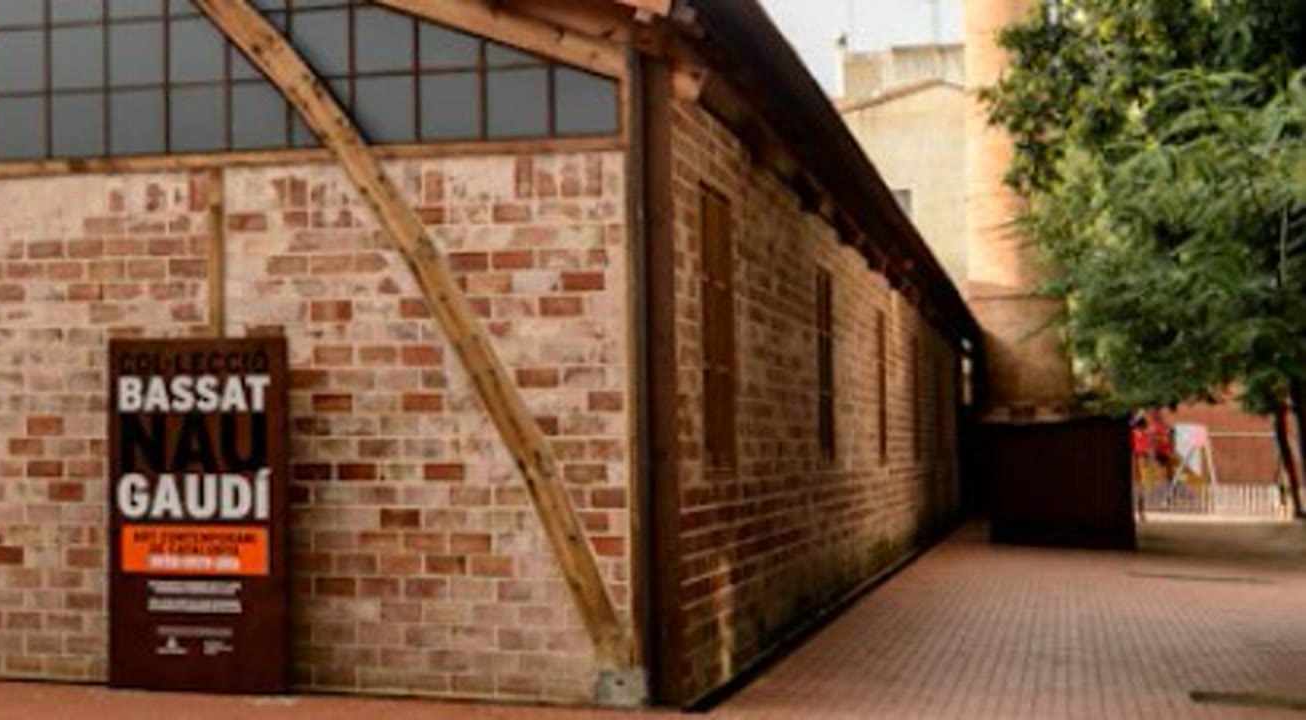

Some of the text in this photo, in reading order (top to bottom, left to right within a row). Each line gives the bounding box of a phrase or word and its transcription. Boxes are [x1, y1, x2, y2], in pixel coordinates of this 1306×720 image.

[118, 374, 271, 413] BASSAT
[119, 412, 268, 473] NAU
[117, 467, 272, 520] GAUDÍ
